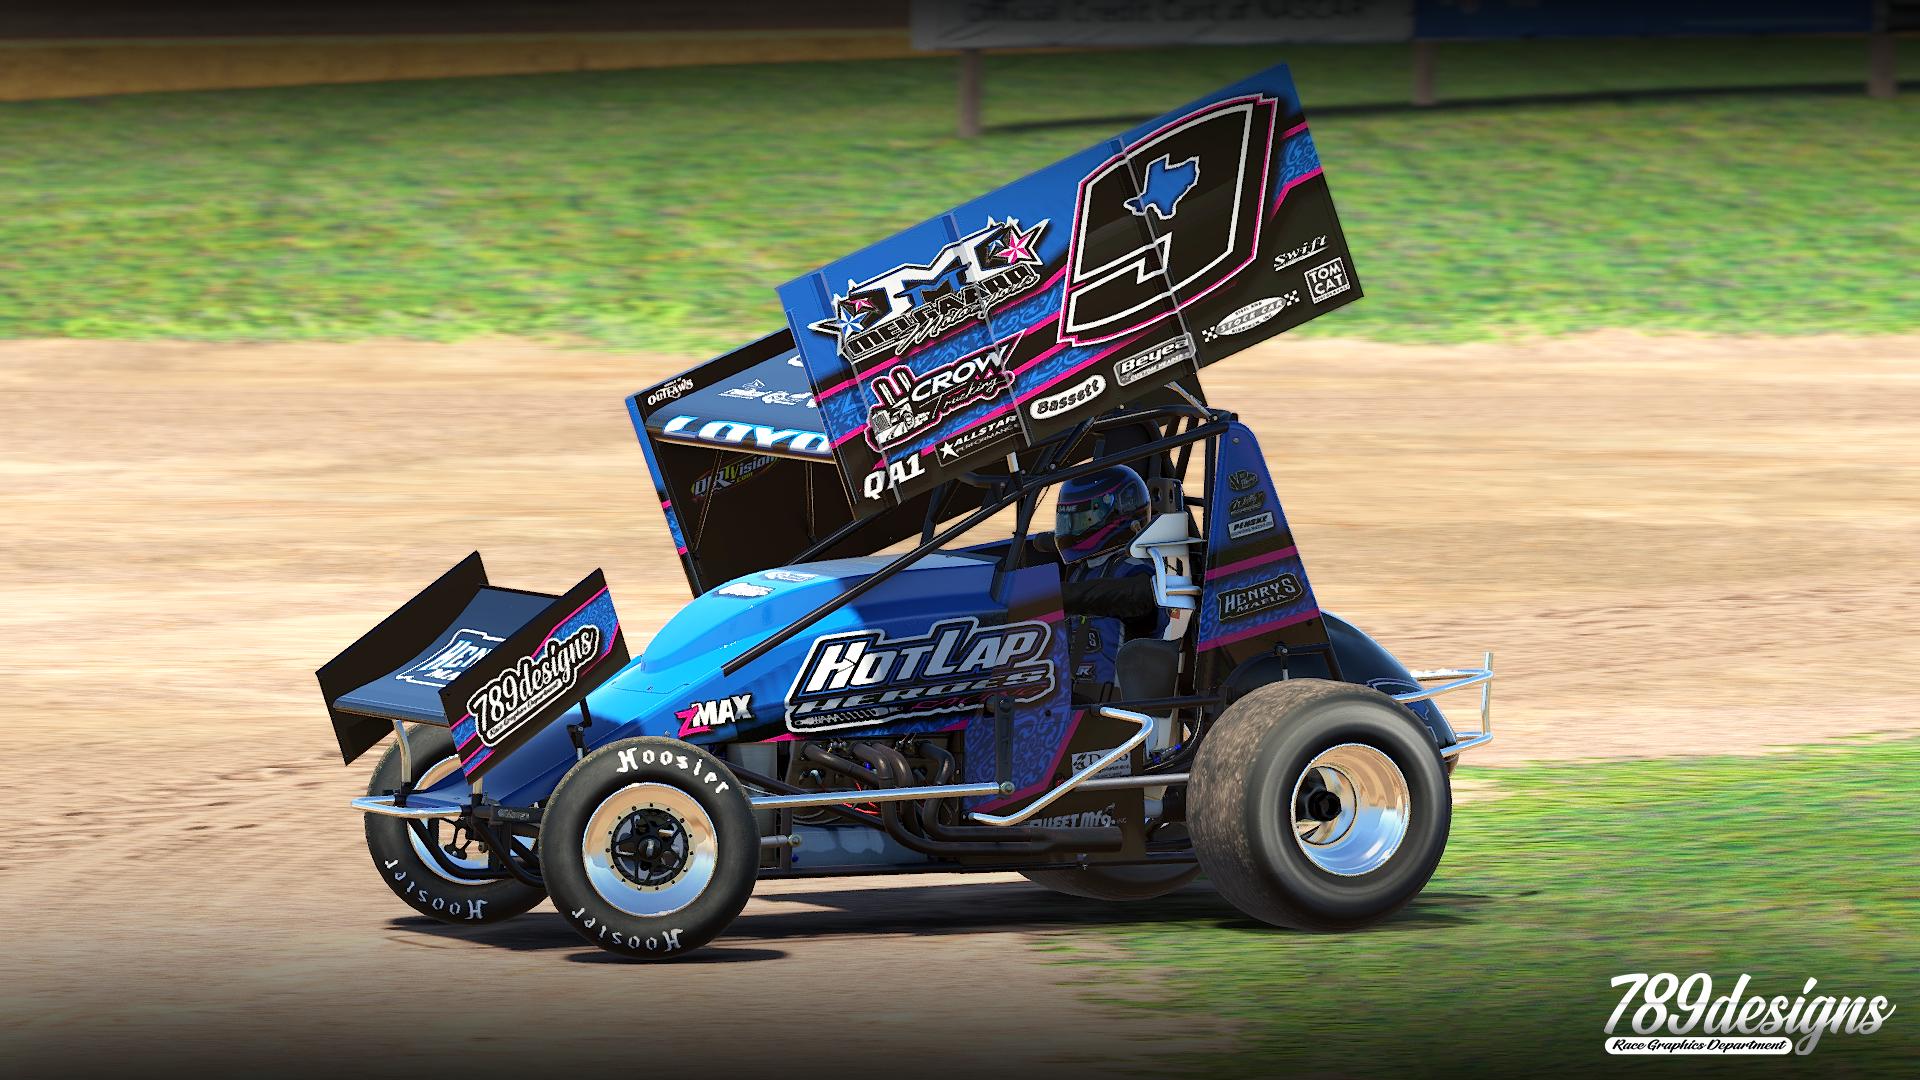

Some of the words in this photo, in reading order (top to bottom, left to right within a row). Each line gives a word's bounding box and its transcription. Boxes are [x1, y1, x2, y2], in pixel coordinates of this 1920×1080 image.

[1060, 96, 1270, 342] 9
[1274, 235, 1328, 268] Swift
[1309, 263, 1342, 284] TOM
[1314, 274, 1344, 296] CAT
[1220, 312, 1256, 332] STOCK
[1261, 300, 1283, 315] CAR
[912, 344, 1009, 401] CROW
[1121, 339, 1189, 374] Beyea
[919, 377, 1006, 419] Trucking
[1036, 378, 1100, 415] Bassett
[954, 415, 1018, 447] ALLSTAR
[863, 453, 926, 500] QA1
[473, 627, 597, 732] 789designs
[616, 747, 730, 794] Hoosier
[384, 859, 489, 920] Hoosier
[571, 907, 684, 952] Hoosier
